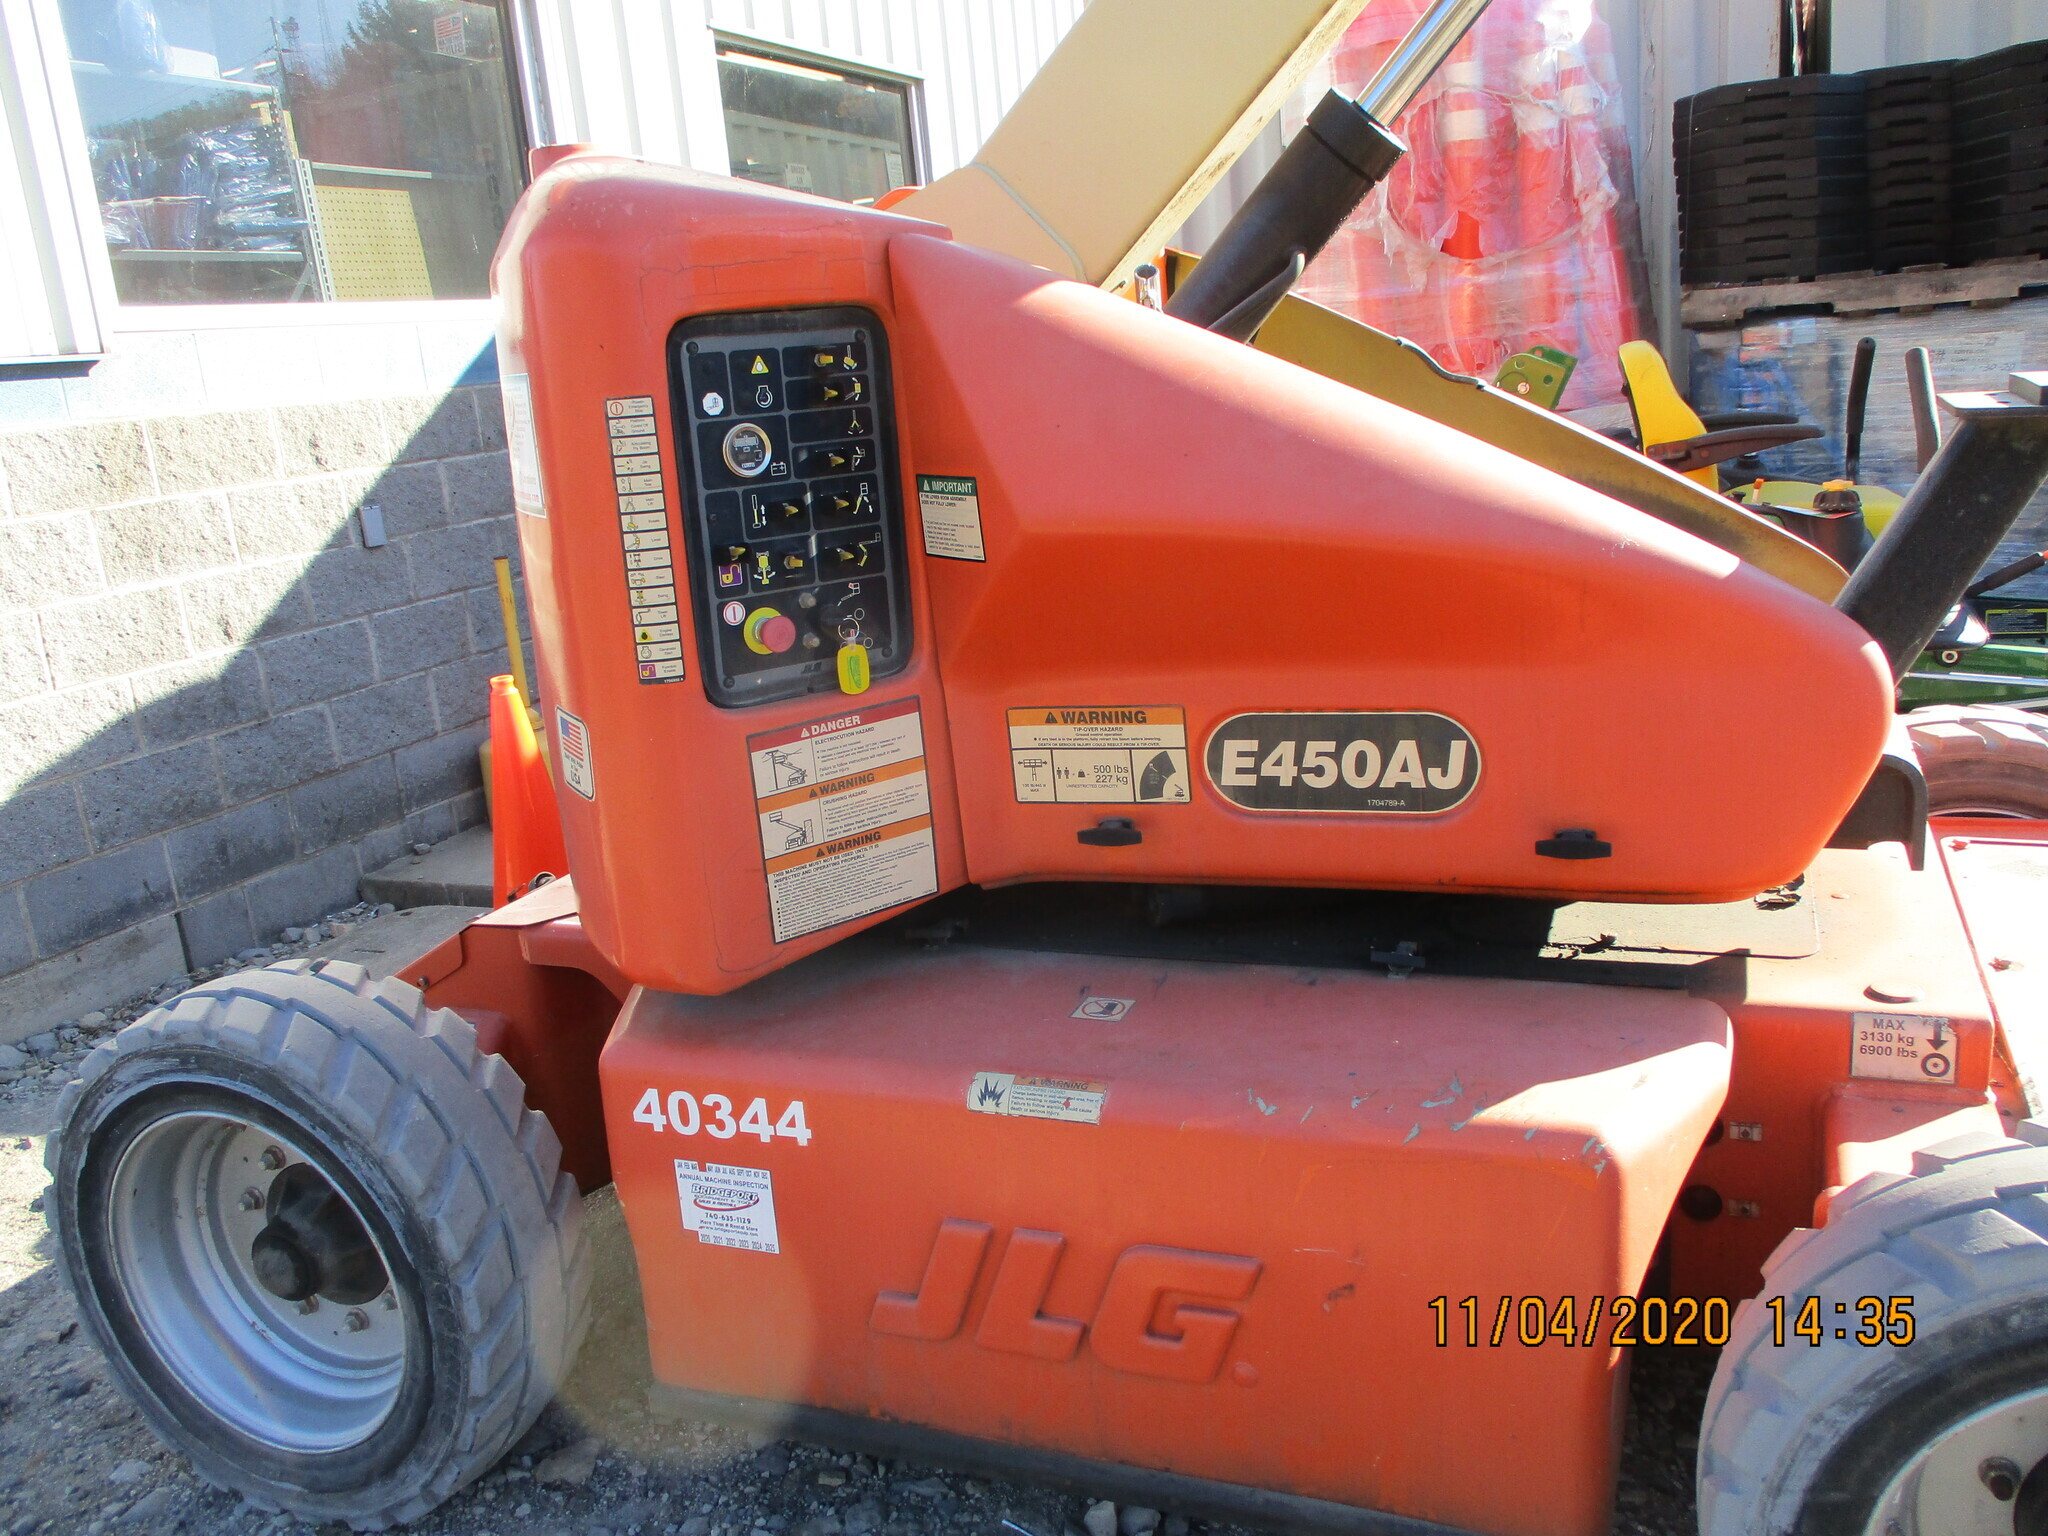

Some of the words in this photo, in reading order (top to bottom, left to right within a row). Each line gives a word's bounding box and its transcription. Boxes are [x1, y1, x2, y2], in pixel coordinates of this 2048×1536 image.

[931, 481, 972, 493] IMPORTANT
[811, 715, 861, 736] DANGER
[1061, 711, 1147, 724] WARNING
[814, 731, 855, 745] ELECTROCUTION
[856, 726, 875, 735] HAZARD
[1093, 765, 1111, 774] 500
[1113, 765, 1129, 774] lbs
[1221, 739, 1468, 790] E450AJ
[819, 773, 875, 796] WARNING
[1095, 775, 1113, 783] 227
[1116, 774, 1129, 785] kg
[822, 795, 848, 805] CRUSHING
[848, 789, 868, 799] HAZARD
[1367, 799, 1406, 807] 1704789-A
[826, 831, 882, 855] WARNING
[773, 872, 800, 883] INSPECTED
[812, 861, 840, 872] OPERATING
[784, 864, 807, 874] MACHINE
[1873, 1018, 1906, 1031] MAX
[1860, 1031, 1893, 1043] 3130
[1897, 1033, 1915, 1047] kg
[1860, 1044, 1893, 1056] 6900
[1897, 1047, 1918, 1058] lbs
[1040, 1079, 1089, 1090] WARNING
[632, 1087, 813, 1146] 40344
[679, 1173, 703, 1182] ANNUAL
[704, 1176, 732, 1185] MACHINE
[732, 1180, 769, 1190] INSPECTION
[691, 1183, 758, 1201] BRIDGEPORT
[705, 1212, 752, 1224] 740-635-1129
[700, 1234, 710, 1242] 2020
[712, 1235, 723, 1243] 2021
[725, 1237, 736, 1245] 2022
[738, 1239, 749, 1247] 2023
[751, 1241, 762, 1249] 2024
[764, 1243, 775, 1251] 2025
[868, 1217, 1263, 1386] JLG
